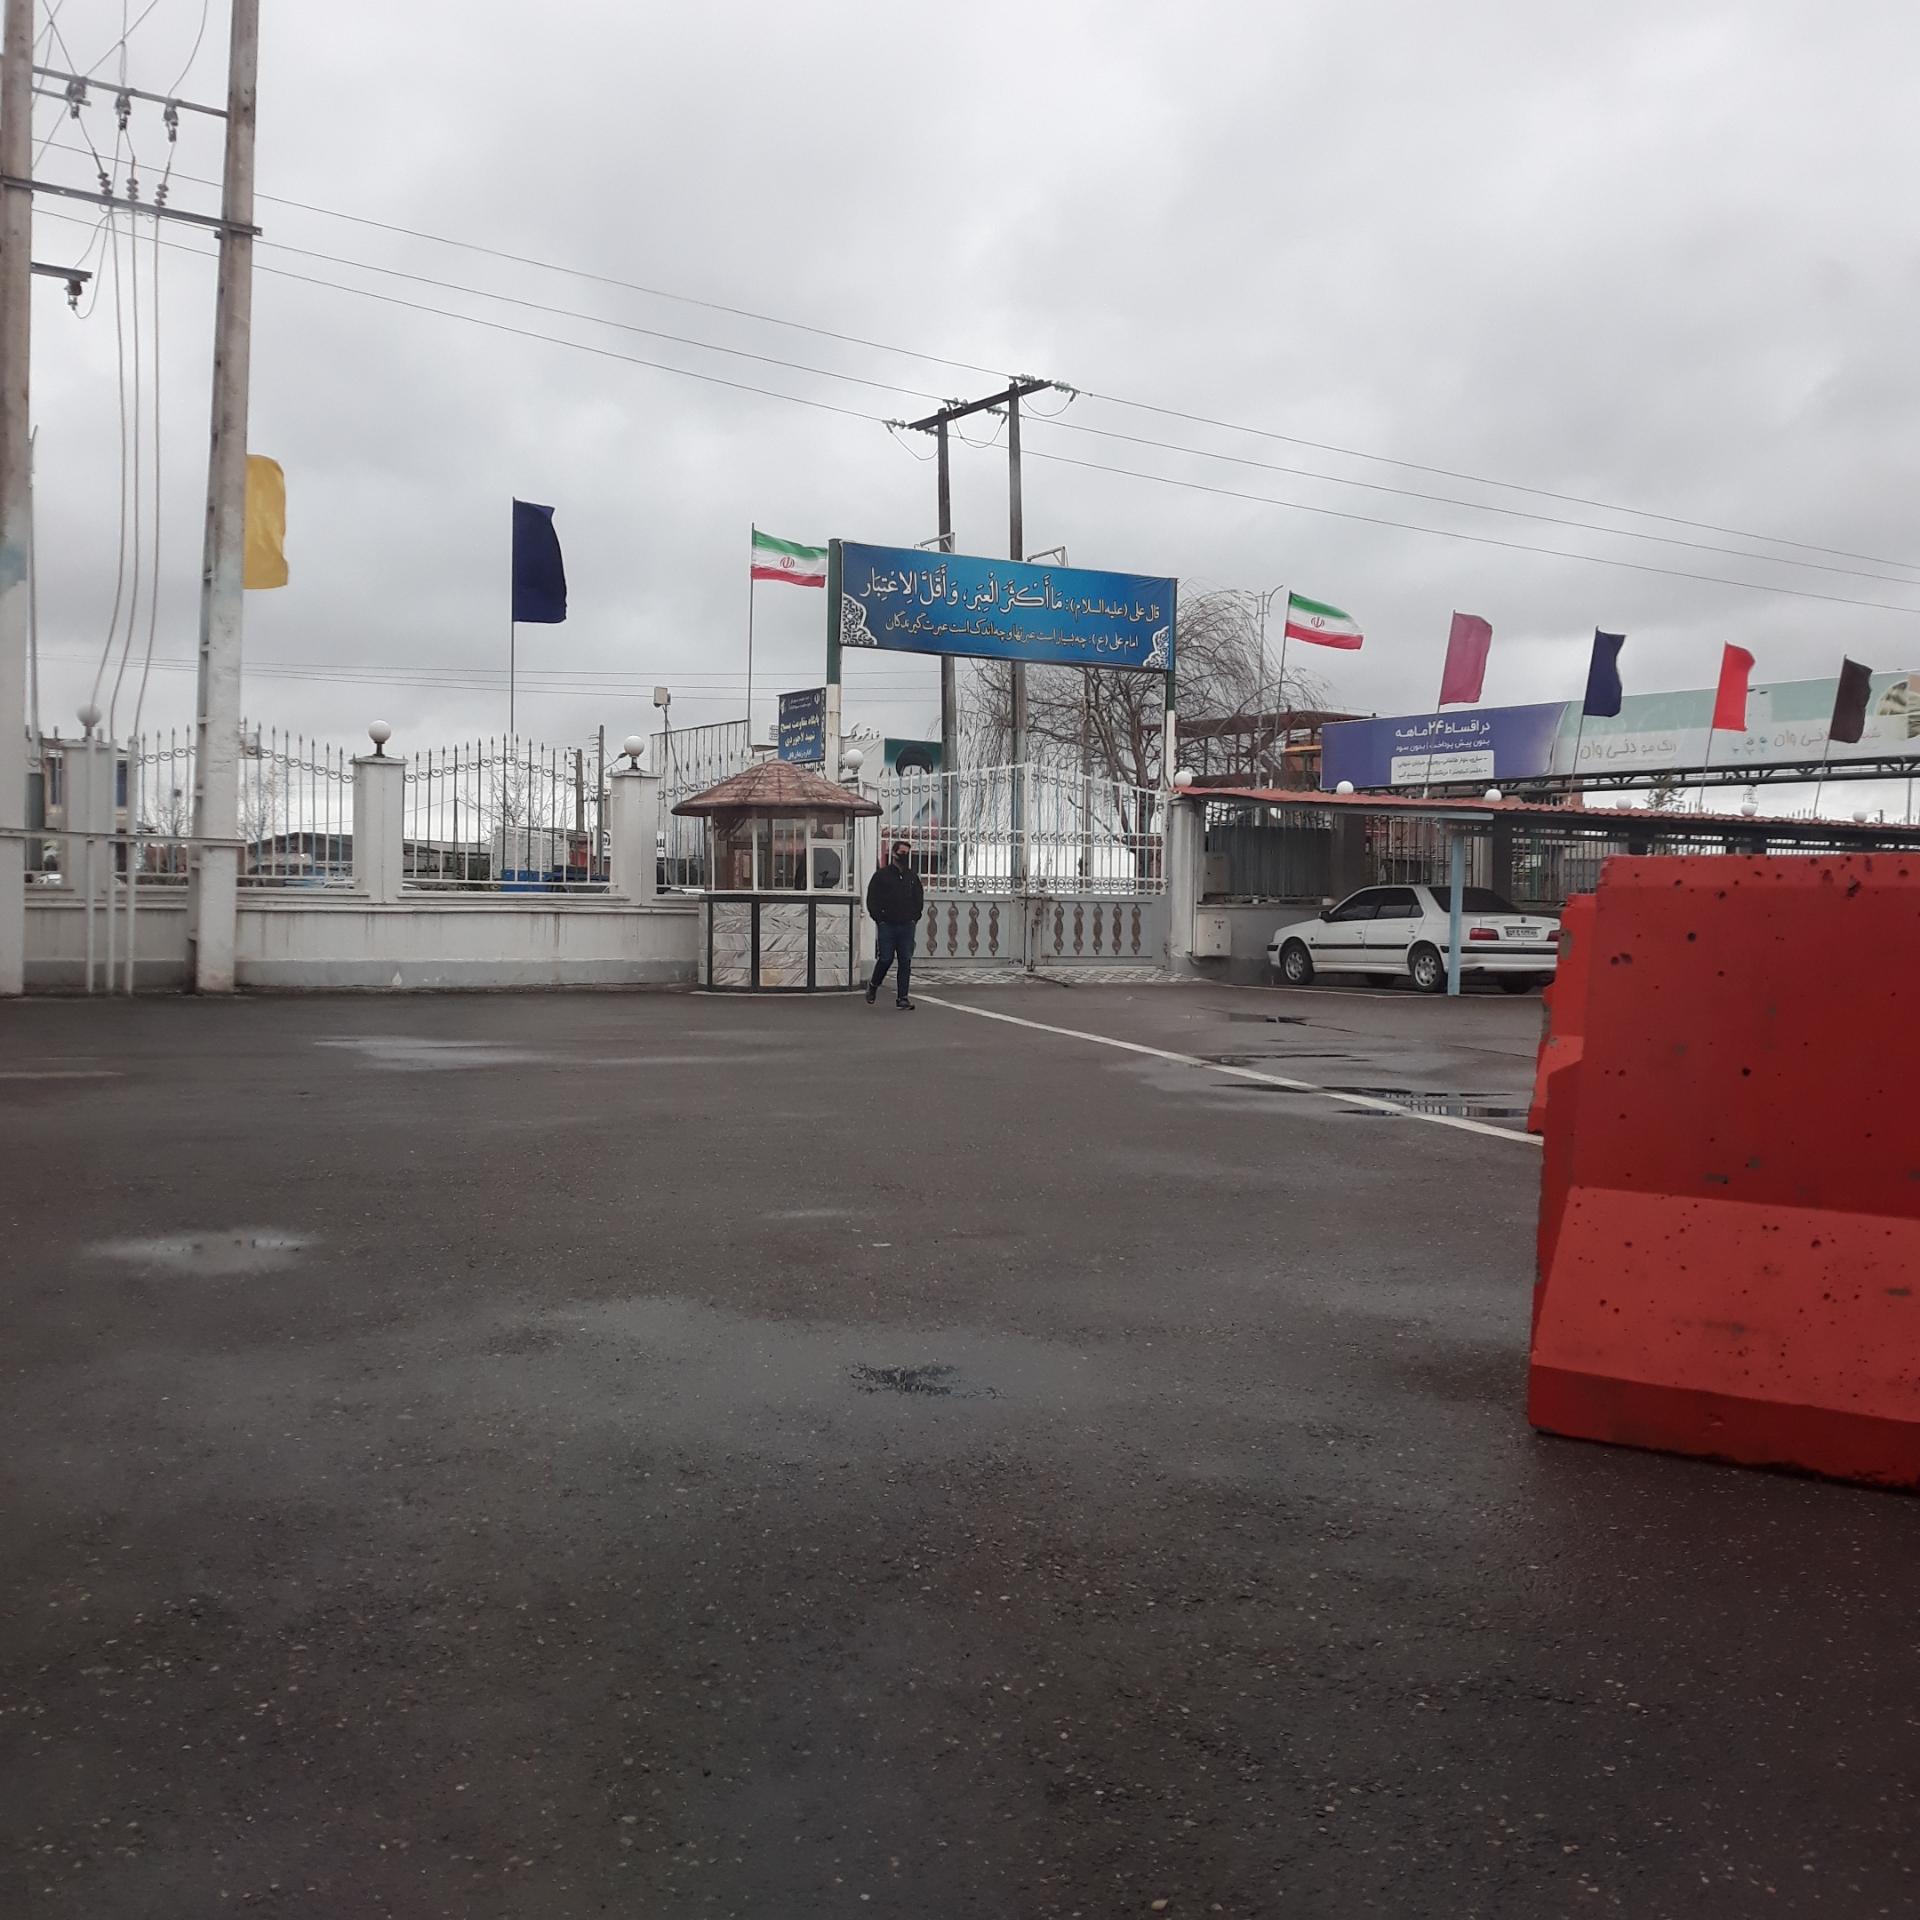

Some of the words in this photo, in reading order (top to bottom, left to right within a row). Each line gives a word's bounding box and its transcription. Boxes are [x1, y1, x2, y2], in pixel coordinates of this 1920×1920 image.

[1146, 603, 1160, 622] قال
[885, 610, 926, 634] گیرندگان
[923, 620, 949, 637] عبرت
[950, 619, 970, 634] است
[993, 627, 1006, 642] چه
[1006, 629, 1013, 641] و
[1036, 627, 1056, 641] است
[1056, 629, 1074, 644] بسیار
[1074, 635, 1087, 648] چه
[1121, 634, 1138, 655] امام
[1395, 726, 1428, 738] ماهه
[1445, 719, 1478, 734] اقساط
[1479, 721, 1491, 735] در
[1409, 744, 1425, 752] بدون
[1455, 739, 1472, 748] پیش
[1473, 739, 1490, 747] بدون
